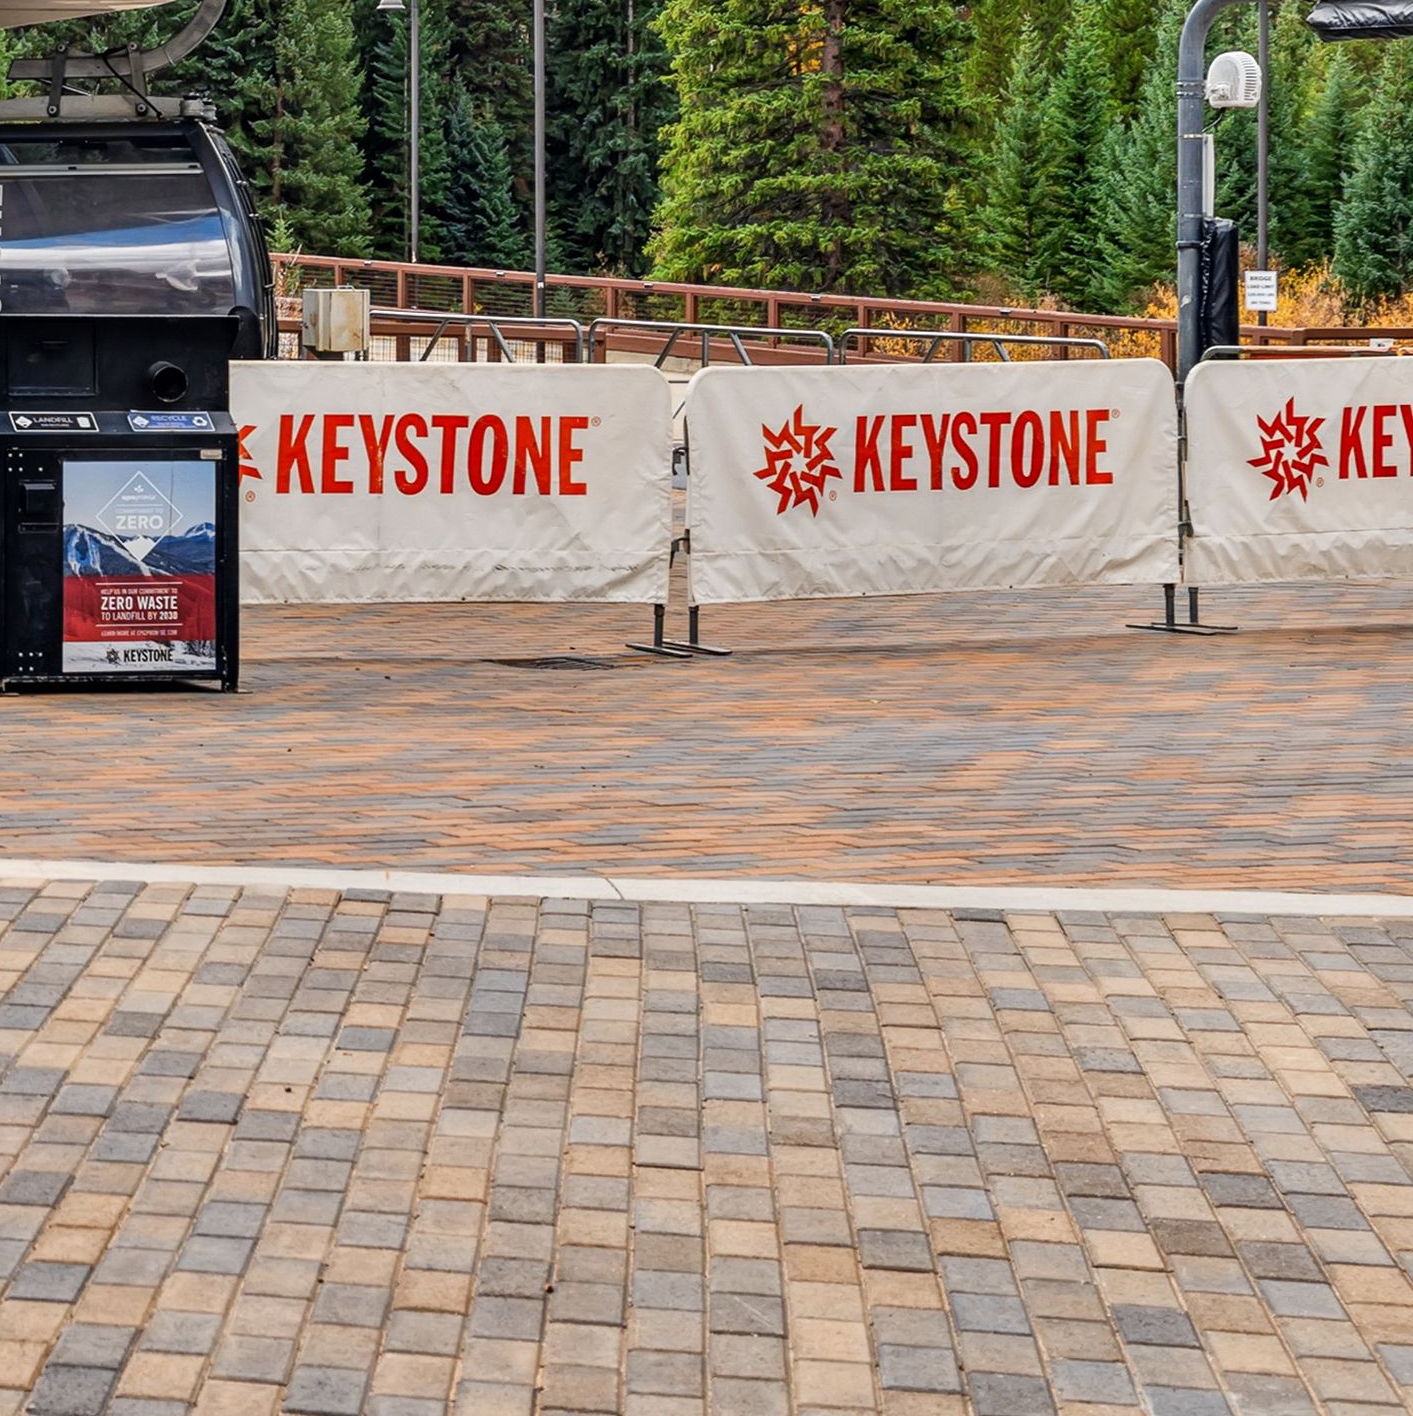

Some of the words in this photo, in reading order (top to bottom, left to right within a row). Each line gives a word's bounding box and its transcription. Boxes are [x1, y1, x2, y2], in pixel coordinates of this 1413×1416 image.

[277, 413, 589, 496] KEYSTONE
[853, 409, 1113, 492] KEYSTONE
[115, 515, 164, 530] ZERO
[101, 596, 133, 610] ZERO
[137, 596, 178, 610] WASTE
[101, 612, 111, 621] TO
[113, 612, 145, 621] LANDFILL
[147, 611, 157, 620] BY
[159, 611, 178, 620] 2030
[123, 649, 173, 662] KEYSTONE
